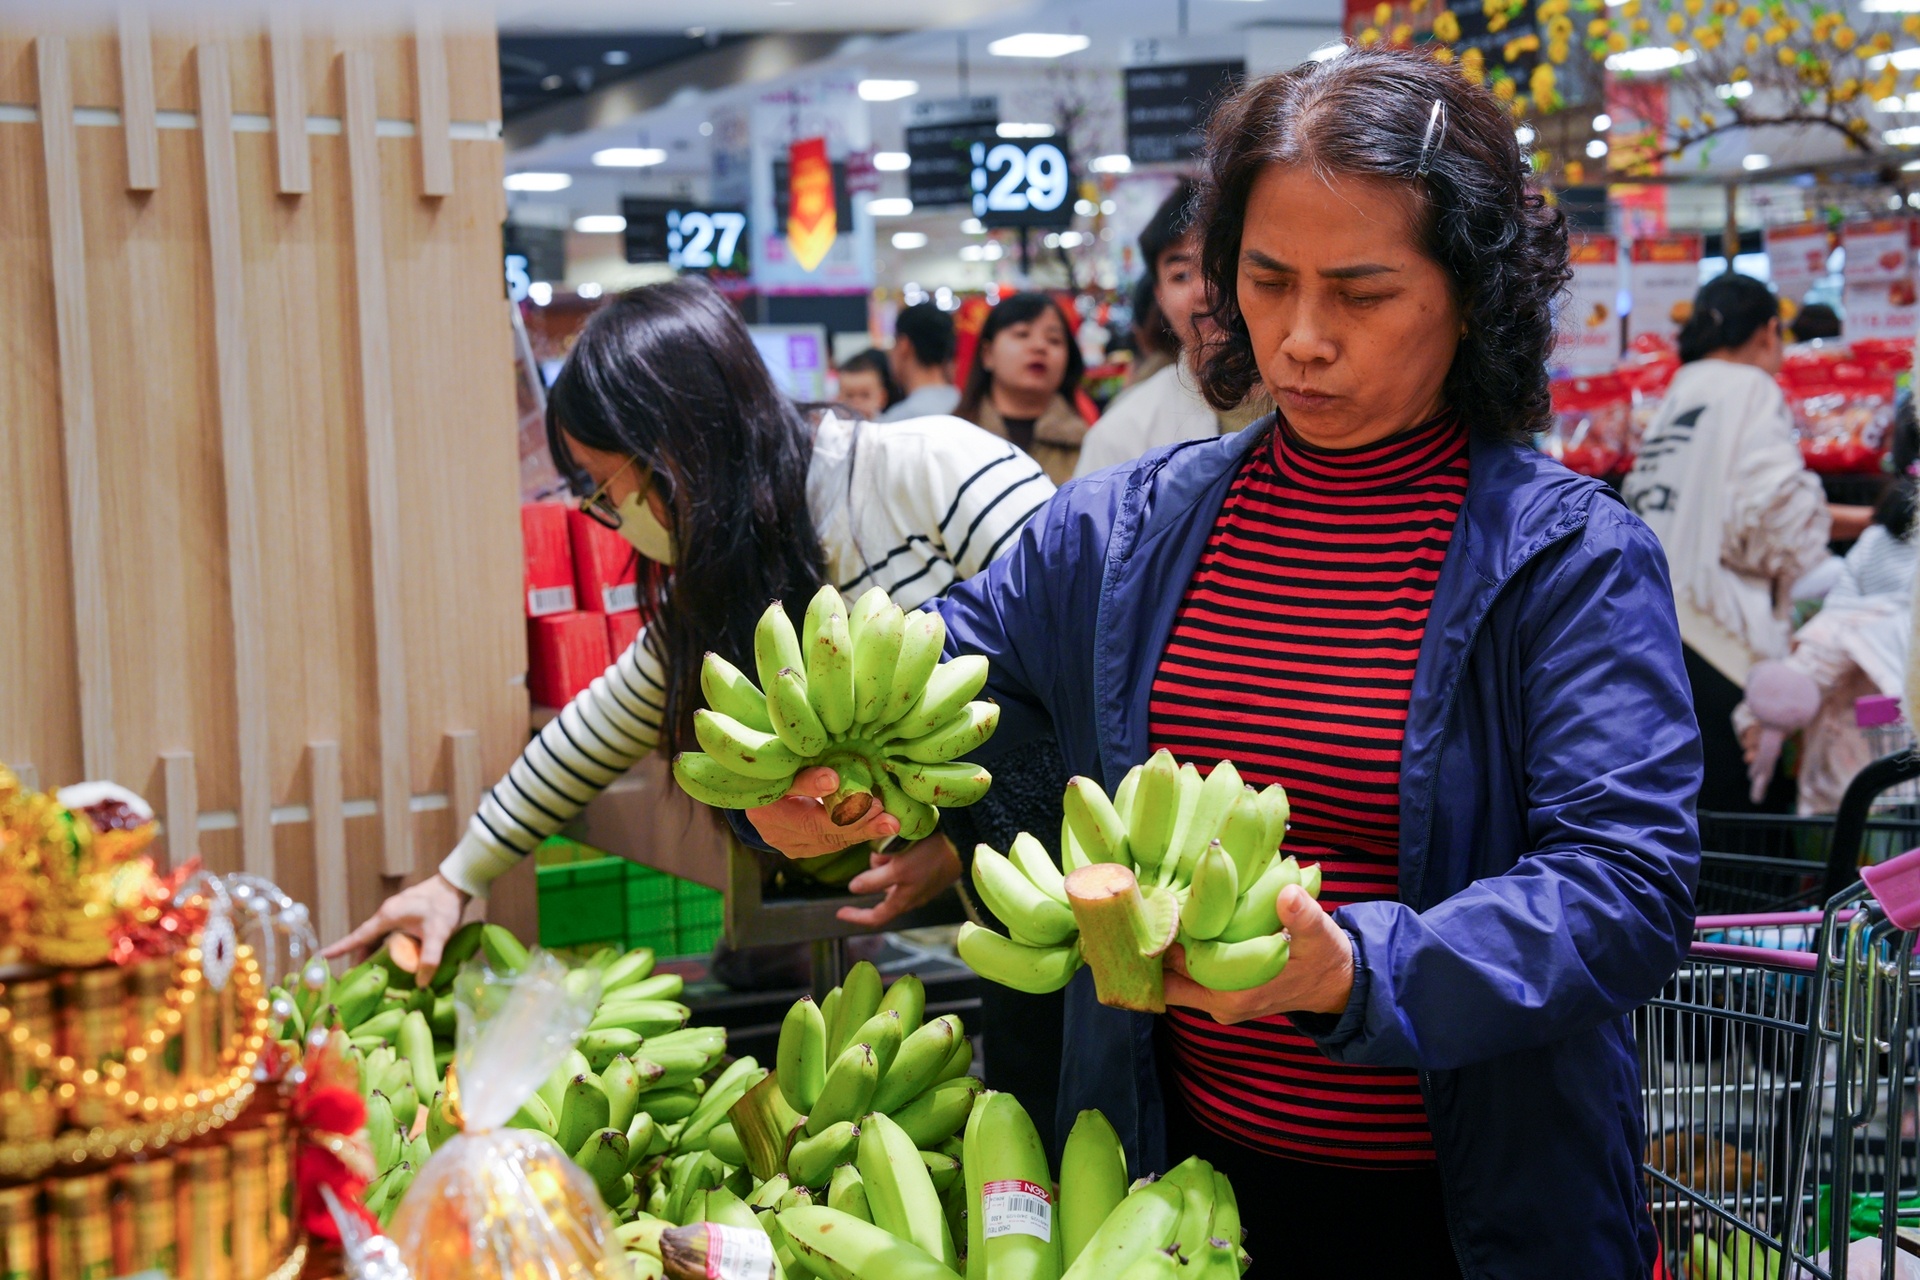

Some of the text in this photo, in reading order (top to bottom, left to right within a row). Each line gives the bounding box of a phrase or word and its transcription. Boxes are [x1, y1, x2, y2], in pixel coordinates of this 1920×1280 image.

[986, 143, 1068, 212] 29
[680, 211, 746, 268] 27
[1024, 1182, 1049, 1199] AEON
